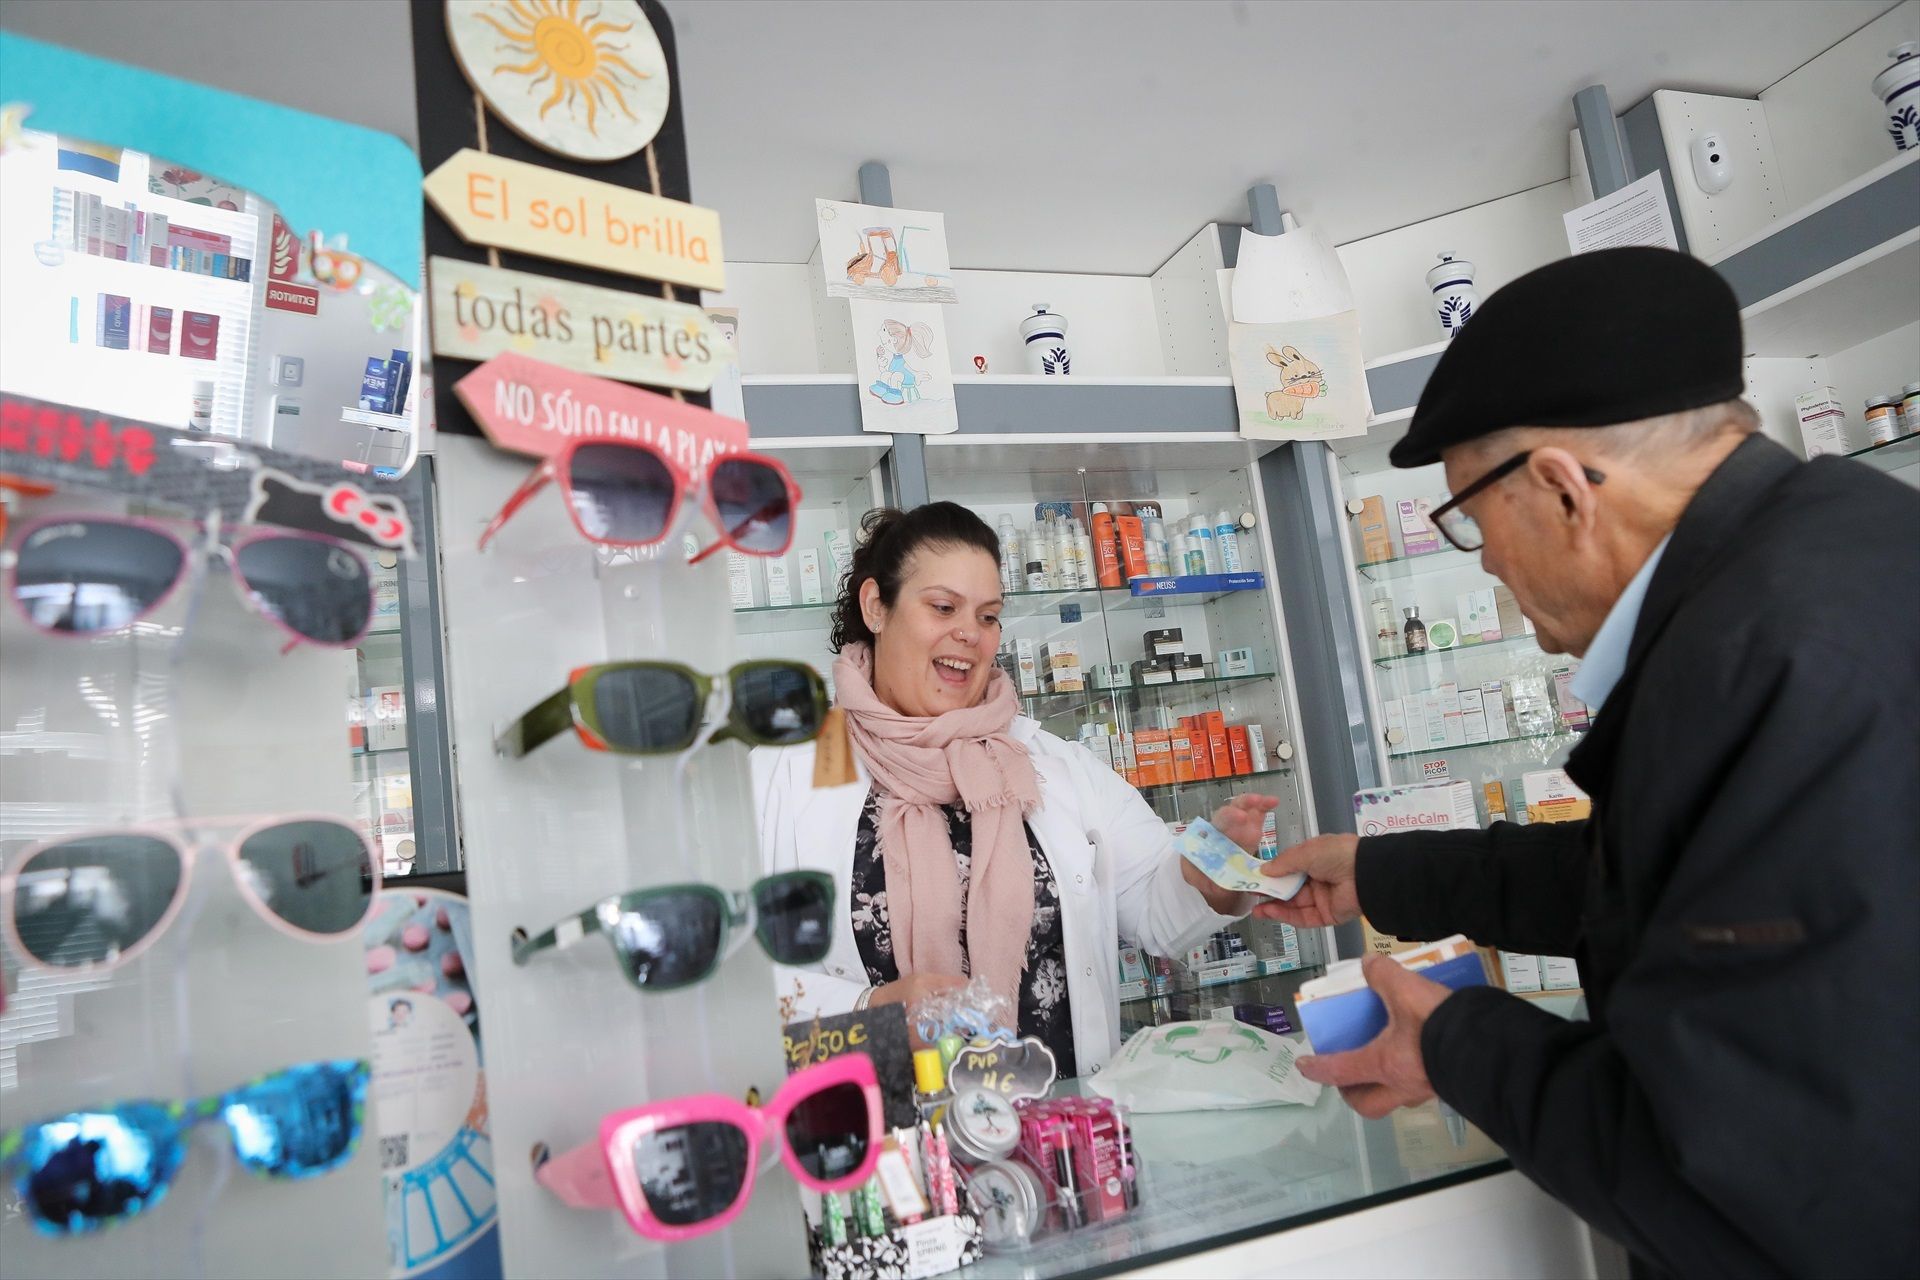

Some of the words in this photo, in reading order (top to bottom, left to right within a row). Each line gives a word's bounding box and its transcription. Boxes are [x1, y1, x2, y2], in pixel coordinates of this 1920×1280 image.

[467, 172, 510, 222] El
[529, 197, 588, 238] sol
[605, 204, 710, 264] brilla
[453, 283, 574, 343] todas
[591, 314, 713, 365] partes
[495, 379, 535, 426] NO
[1156, 581, 1176, 590] NEUSC
[1424, 760, 1446, 769] STOP
[1387, 813, 1449, 827] BlefaCalm
[1232, 881, 1260, 890] 20
[968, 1052, 998, 1071] PVP
